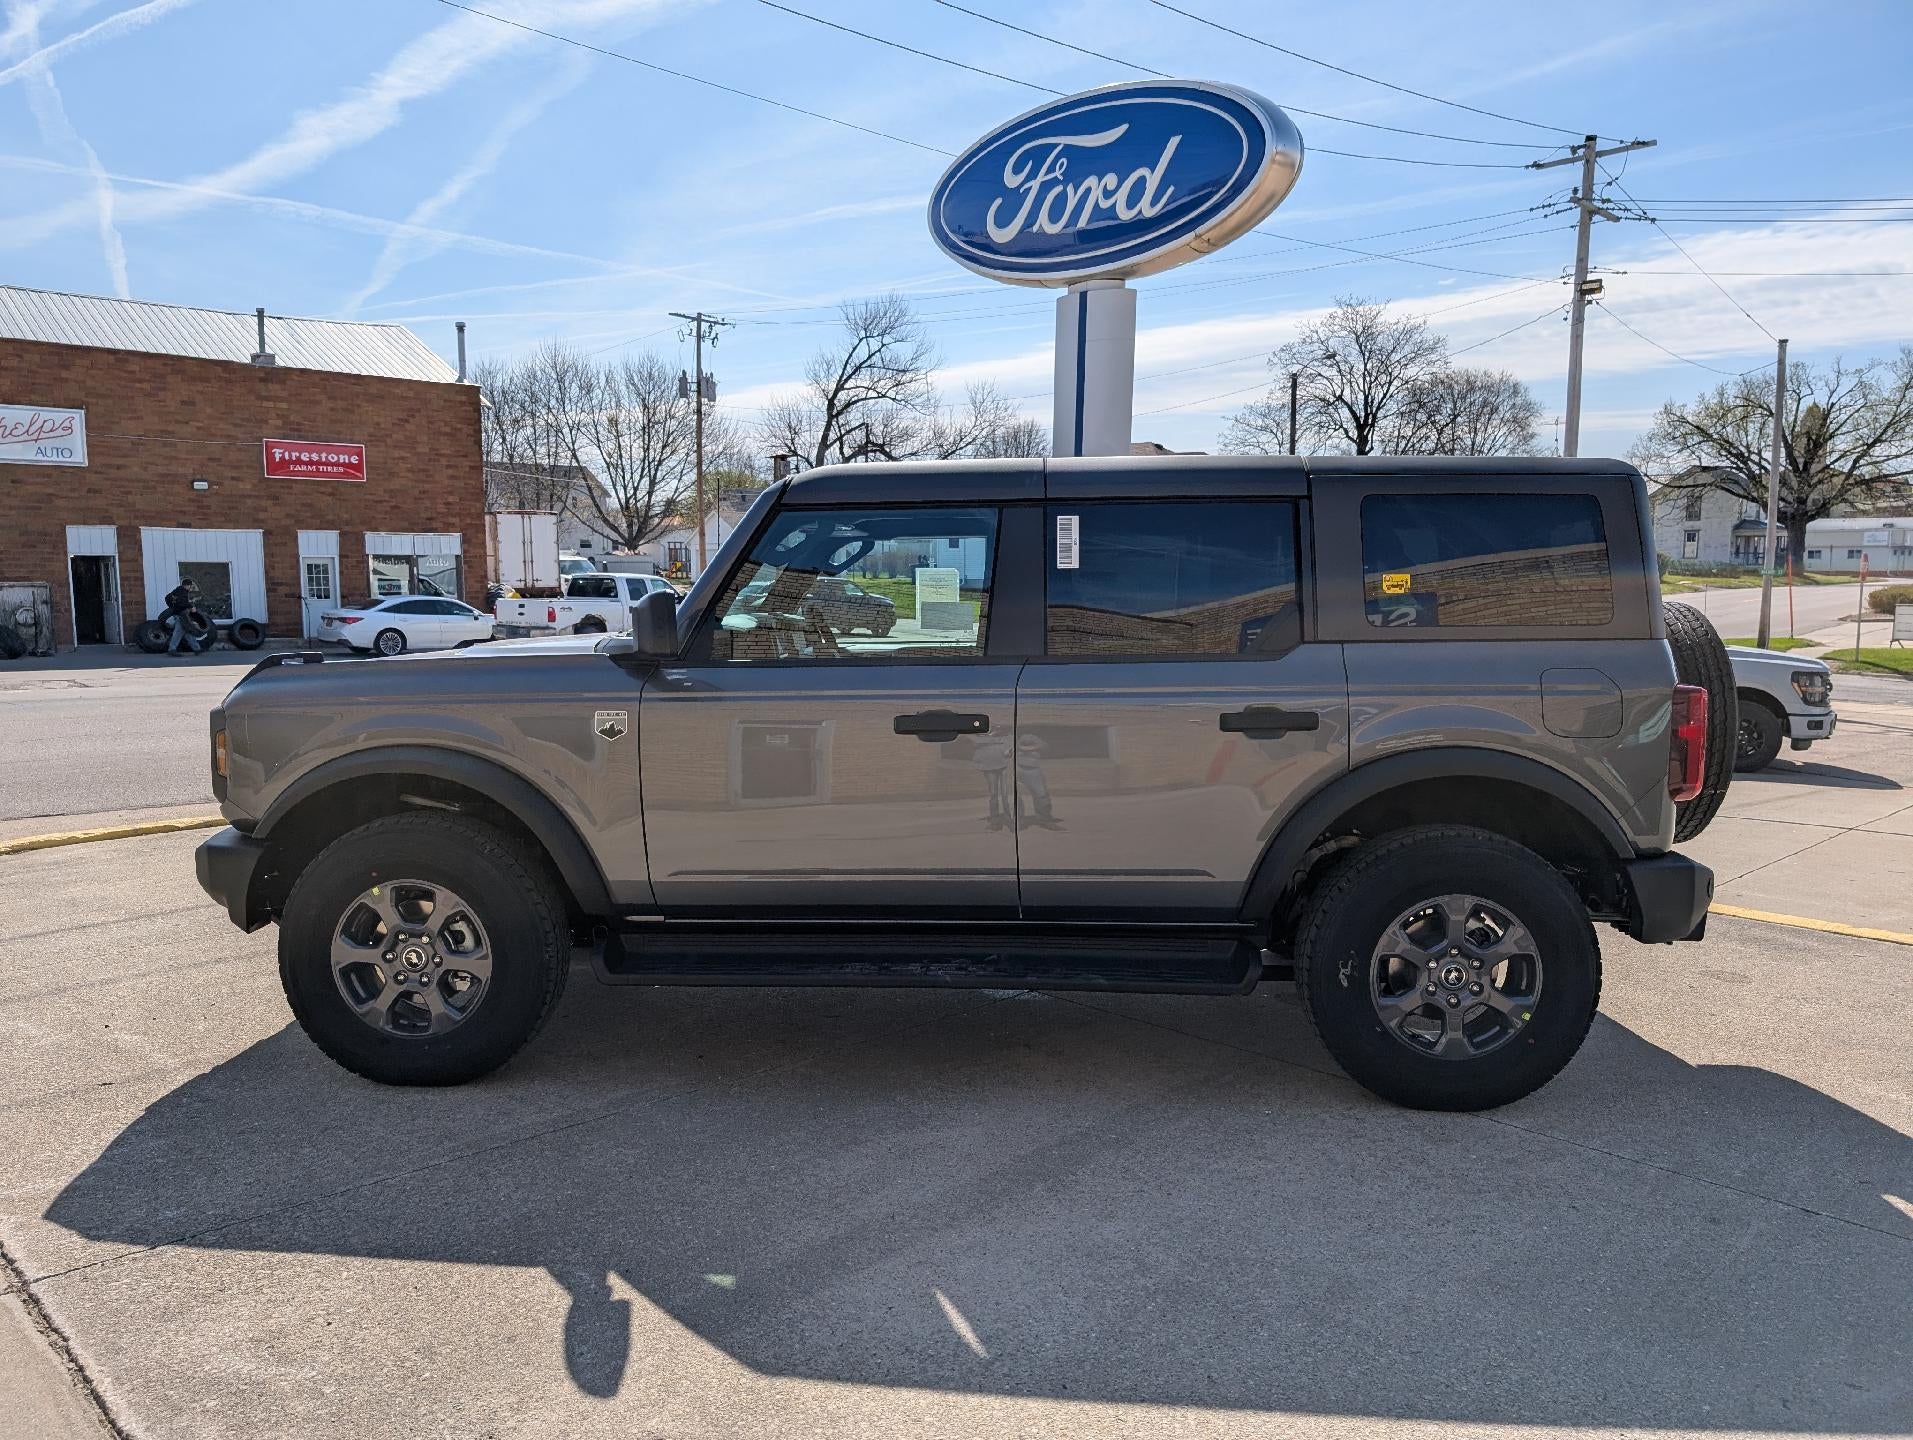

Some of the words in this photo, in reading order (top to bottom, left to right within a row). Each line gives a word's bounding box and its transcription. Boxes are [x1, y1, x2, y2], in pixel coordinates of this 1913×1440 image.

[986, 123, 1182, 244] Ford
[0, 412, 75, 444] helps
[35, 446, 73, 459] AUTO
[272, 448, 360, 464] Firestone
[290, 464, 317, 472] FARM
[318, 465, 344, 473] TIRES
